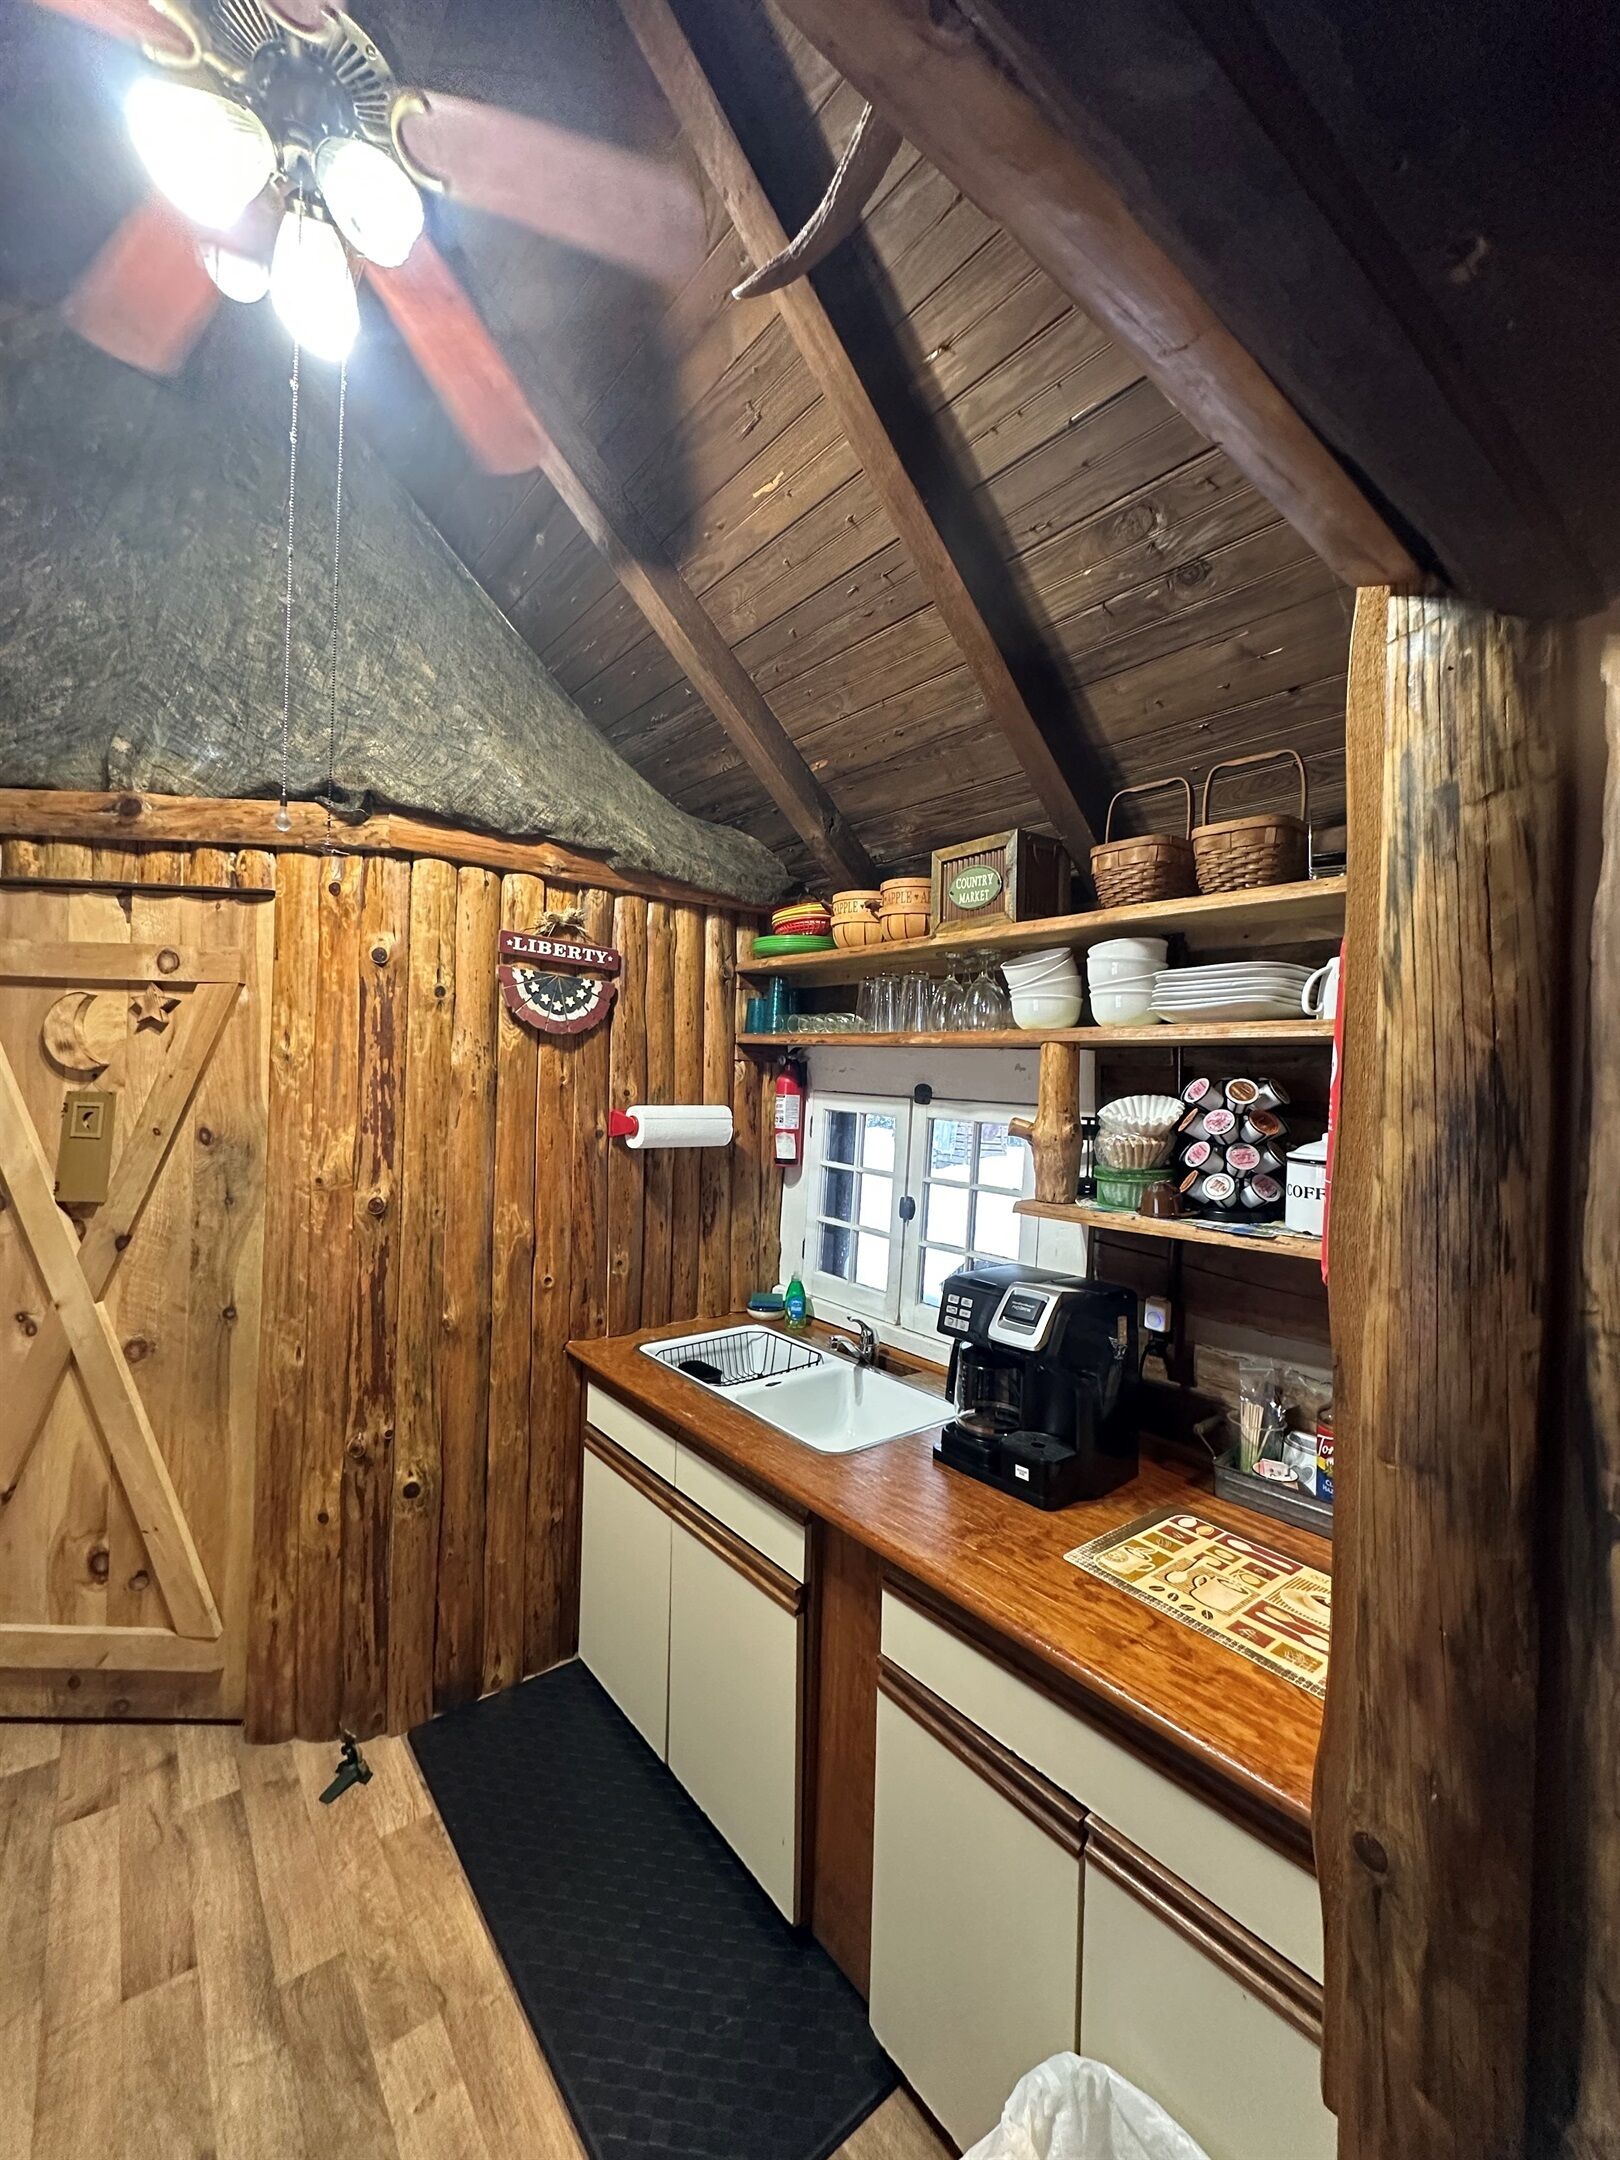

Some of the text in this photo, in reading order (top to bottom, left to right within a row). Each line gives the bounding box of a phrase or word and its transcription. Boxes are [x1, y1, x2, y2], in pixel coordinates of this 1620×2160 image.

[956, 873, 994, 889] COUNTRY
[887, 891, 912, 905] APPLE
[959, 890, 989, 904] MARKET
[835, 901, 858, 914] APPLE
[512, 936, 609, 964] LIBERTY
